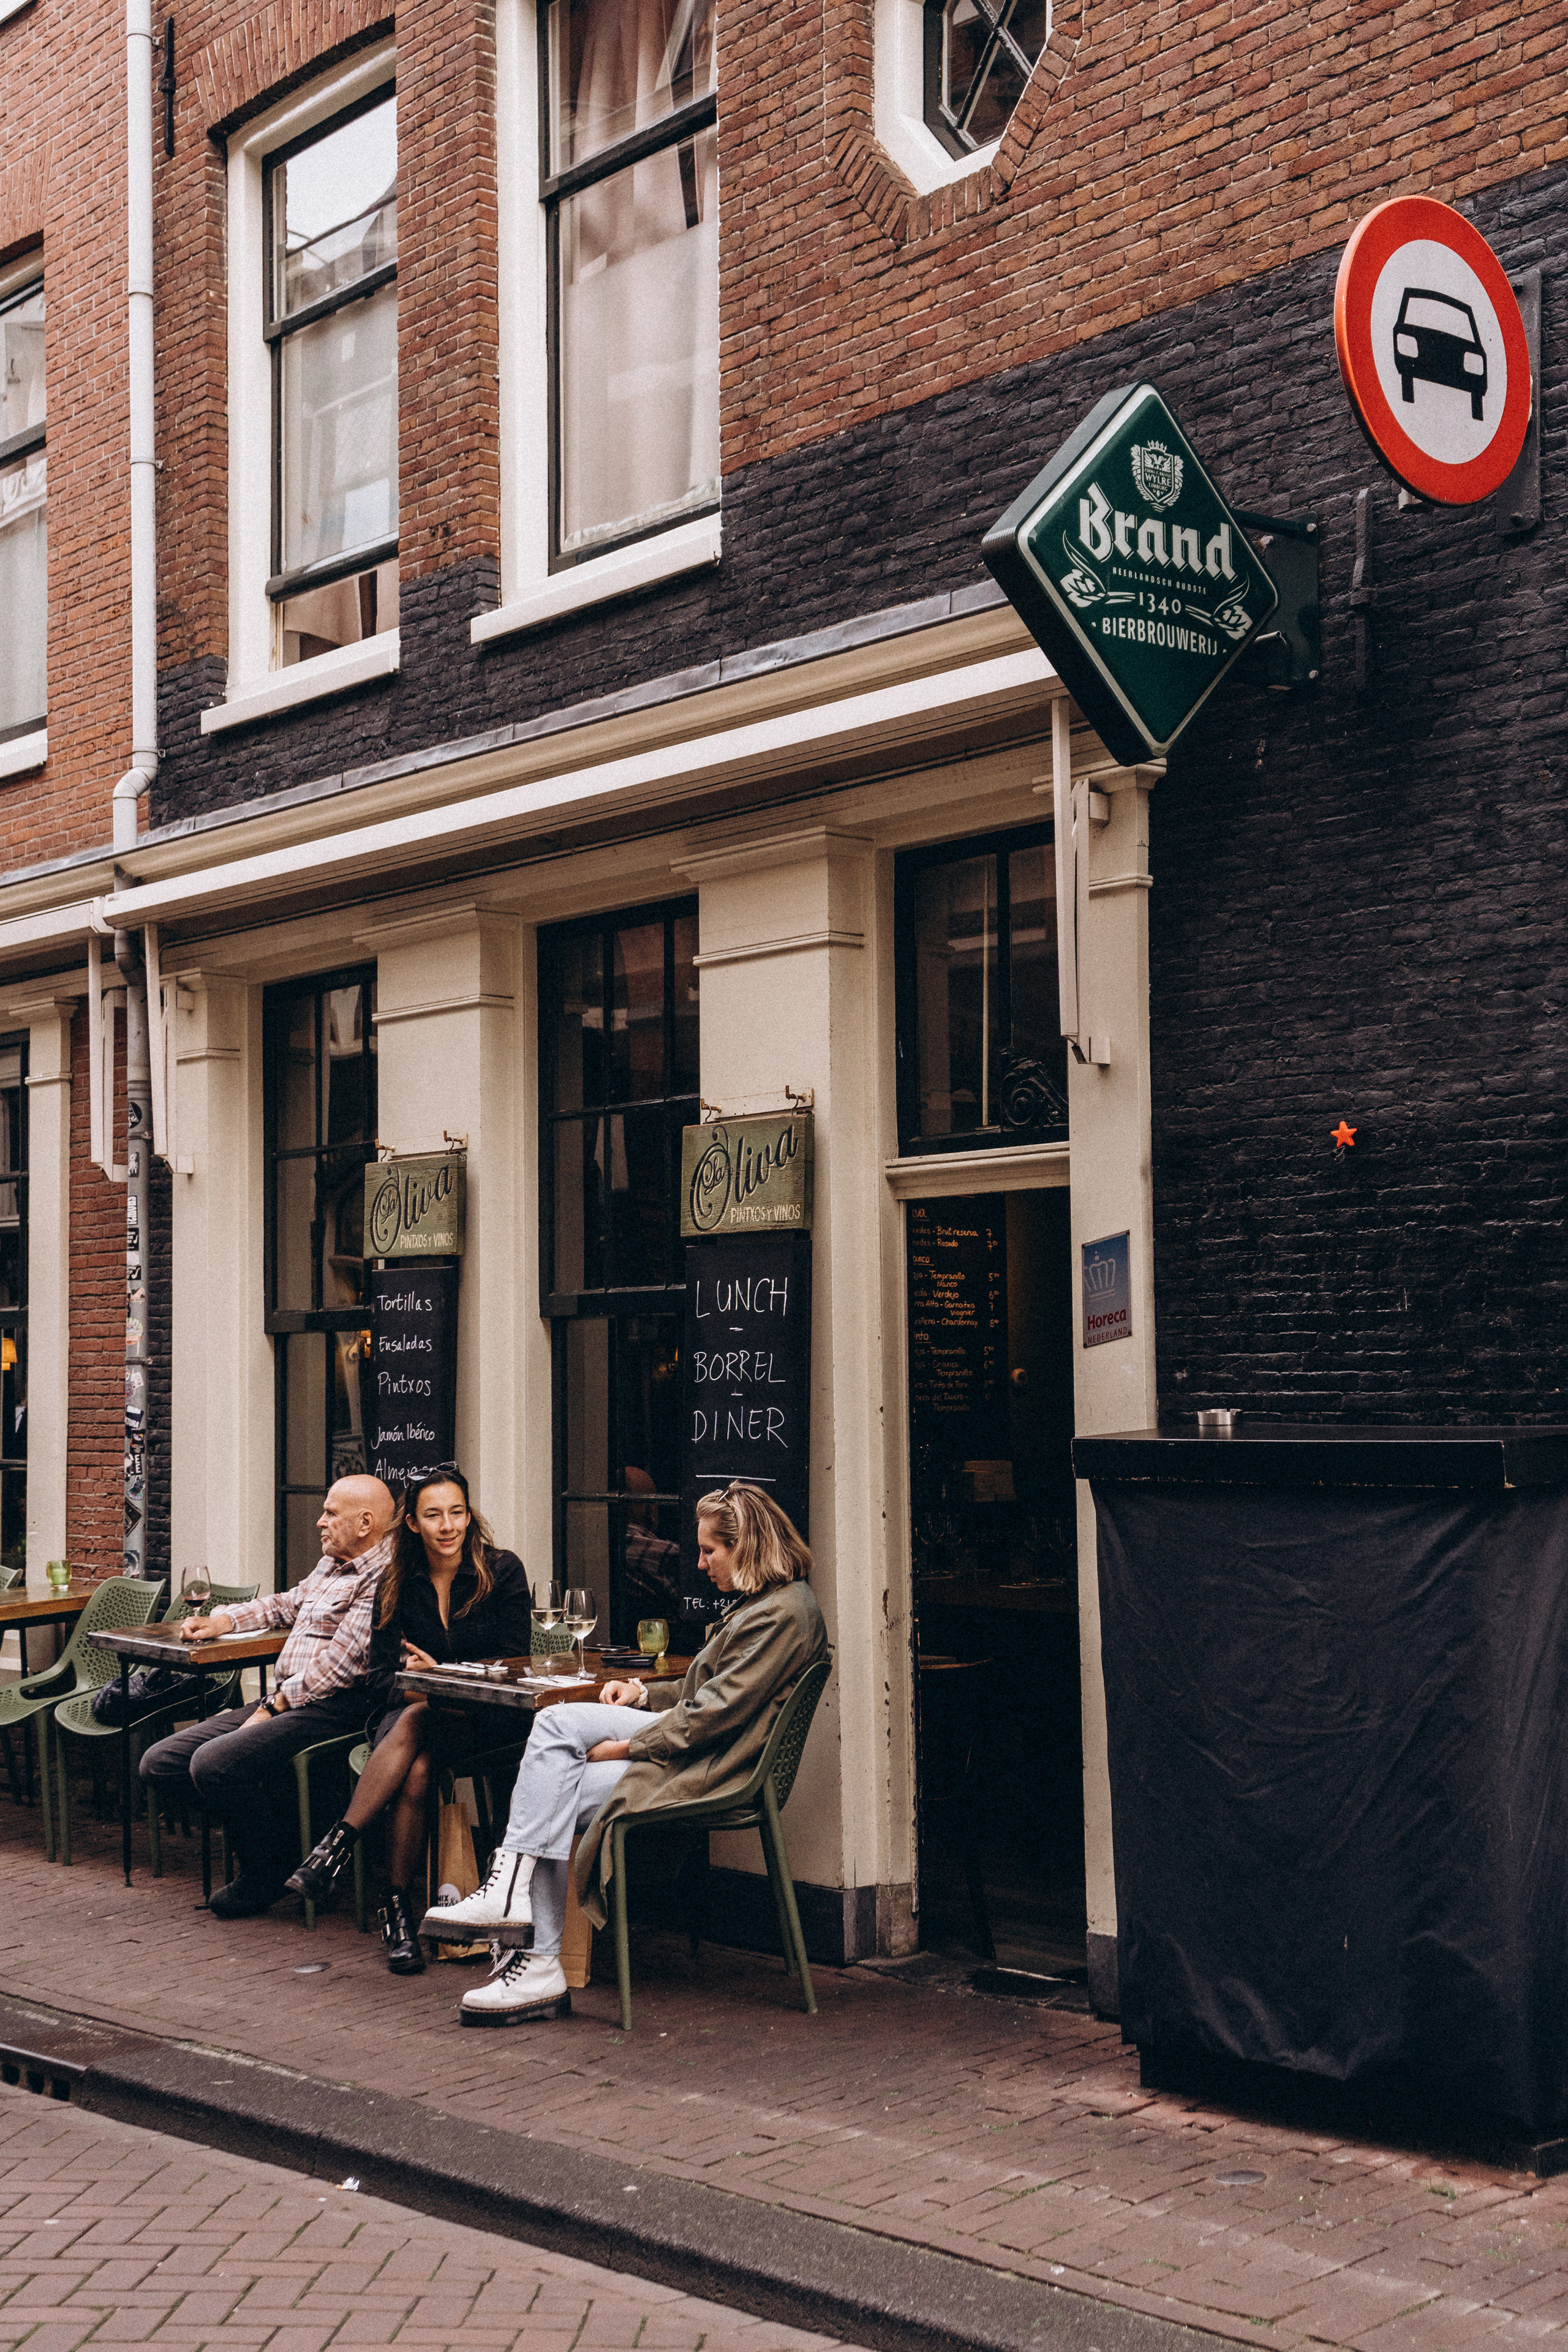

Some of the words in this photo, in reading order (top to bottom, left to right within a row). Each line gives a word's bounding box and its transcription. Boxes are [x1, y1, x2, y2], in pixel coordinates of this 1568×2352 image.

[1144, 473, 1172, 487] WYLRE
[1148, 482, 1168, 491] LIMBURG
[1079, 481, 1238, 583] Brand
[1112, 567, 1172, 587] NEERLANDSCH
[1176, 581, 1207, 594] OUDSTE
[1139, 592, 1182, 616] 1340
[1102, 617, 1218, 655] BIERBROUWERIJ
[690, 1125, 799, 1232] Oliva
[370, 1164, 453, 1254] Oliva
[730, 1206, 766, 1224] PINTXOS
[774, 1204, 801, 1221] VINOS
[936, 1226, 952, 1235] Brut
[400, 1234, 427, 1249] PINTXOS
[433, 1232, 453, 1247] VINOS
[937, 1238, 959, 1247] Rosado
[929, 1270, 965, 1281] Tempranillo
[377, 1291, 432, 1311] Tortillas
[696, 1277, 788, 1318] LUNCH
[932, 1289, 959, 1300] Verdejo
[941, 1317, 978, 1329] Chardonnay
[950, 1310, 975, 1319] Viognier
[1087, 1309, 1127, 1330] Horeca
[379, 1333, 432, 1352] Ensaladas
[1088, 1326, 1127, 1345] NEDERLAND
[930, 1346, 966, 1356] Tempranillo
[693, 1350, 786, 1382] BORREL
[932, 1360, 959, 1368] Crianza
[936, 1369, 973, 1378] Tempranillo
[377, 1371, 431, 1396] Pintxos
[932, 1403, 970, 1412] Tempranillo
[371, 1425, 404, 1450] Jamón
[407, 1422, 435, 1441] Ibérico
[692, 1406, 788, 1448] DINER
[684, 1597, 709, 1610] TEL:
[713, 1599, 738, 1610] +31
